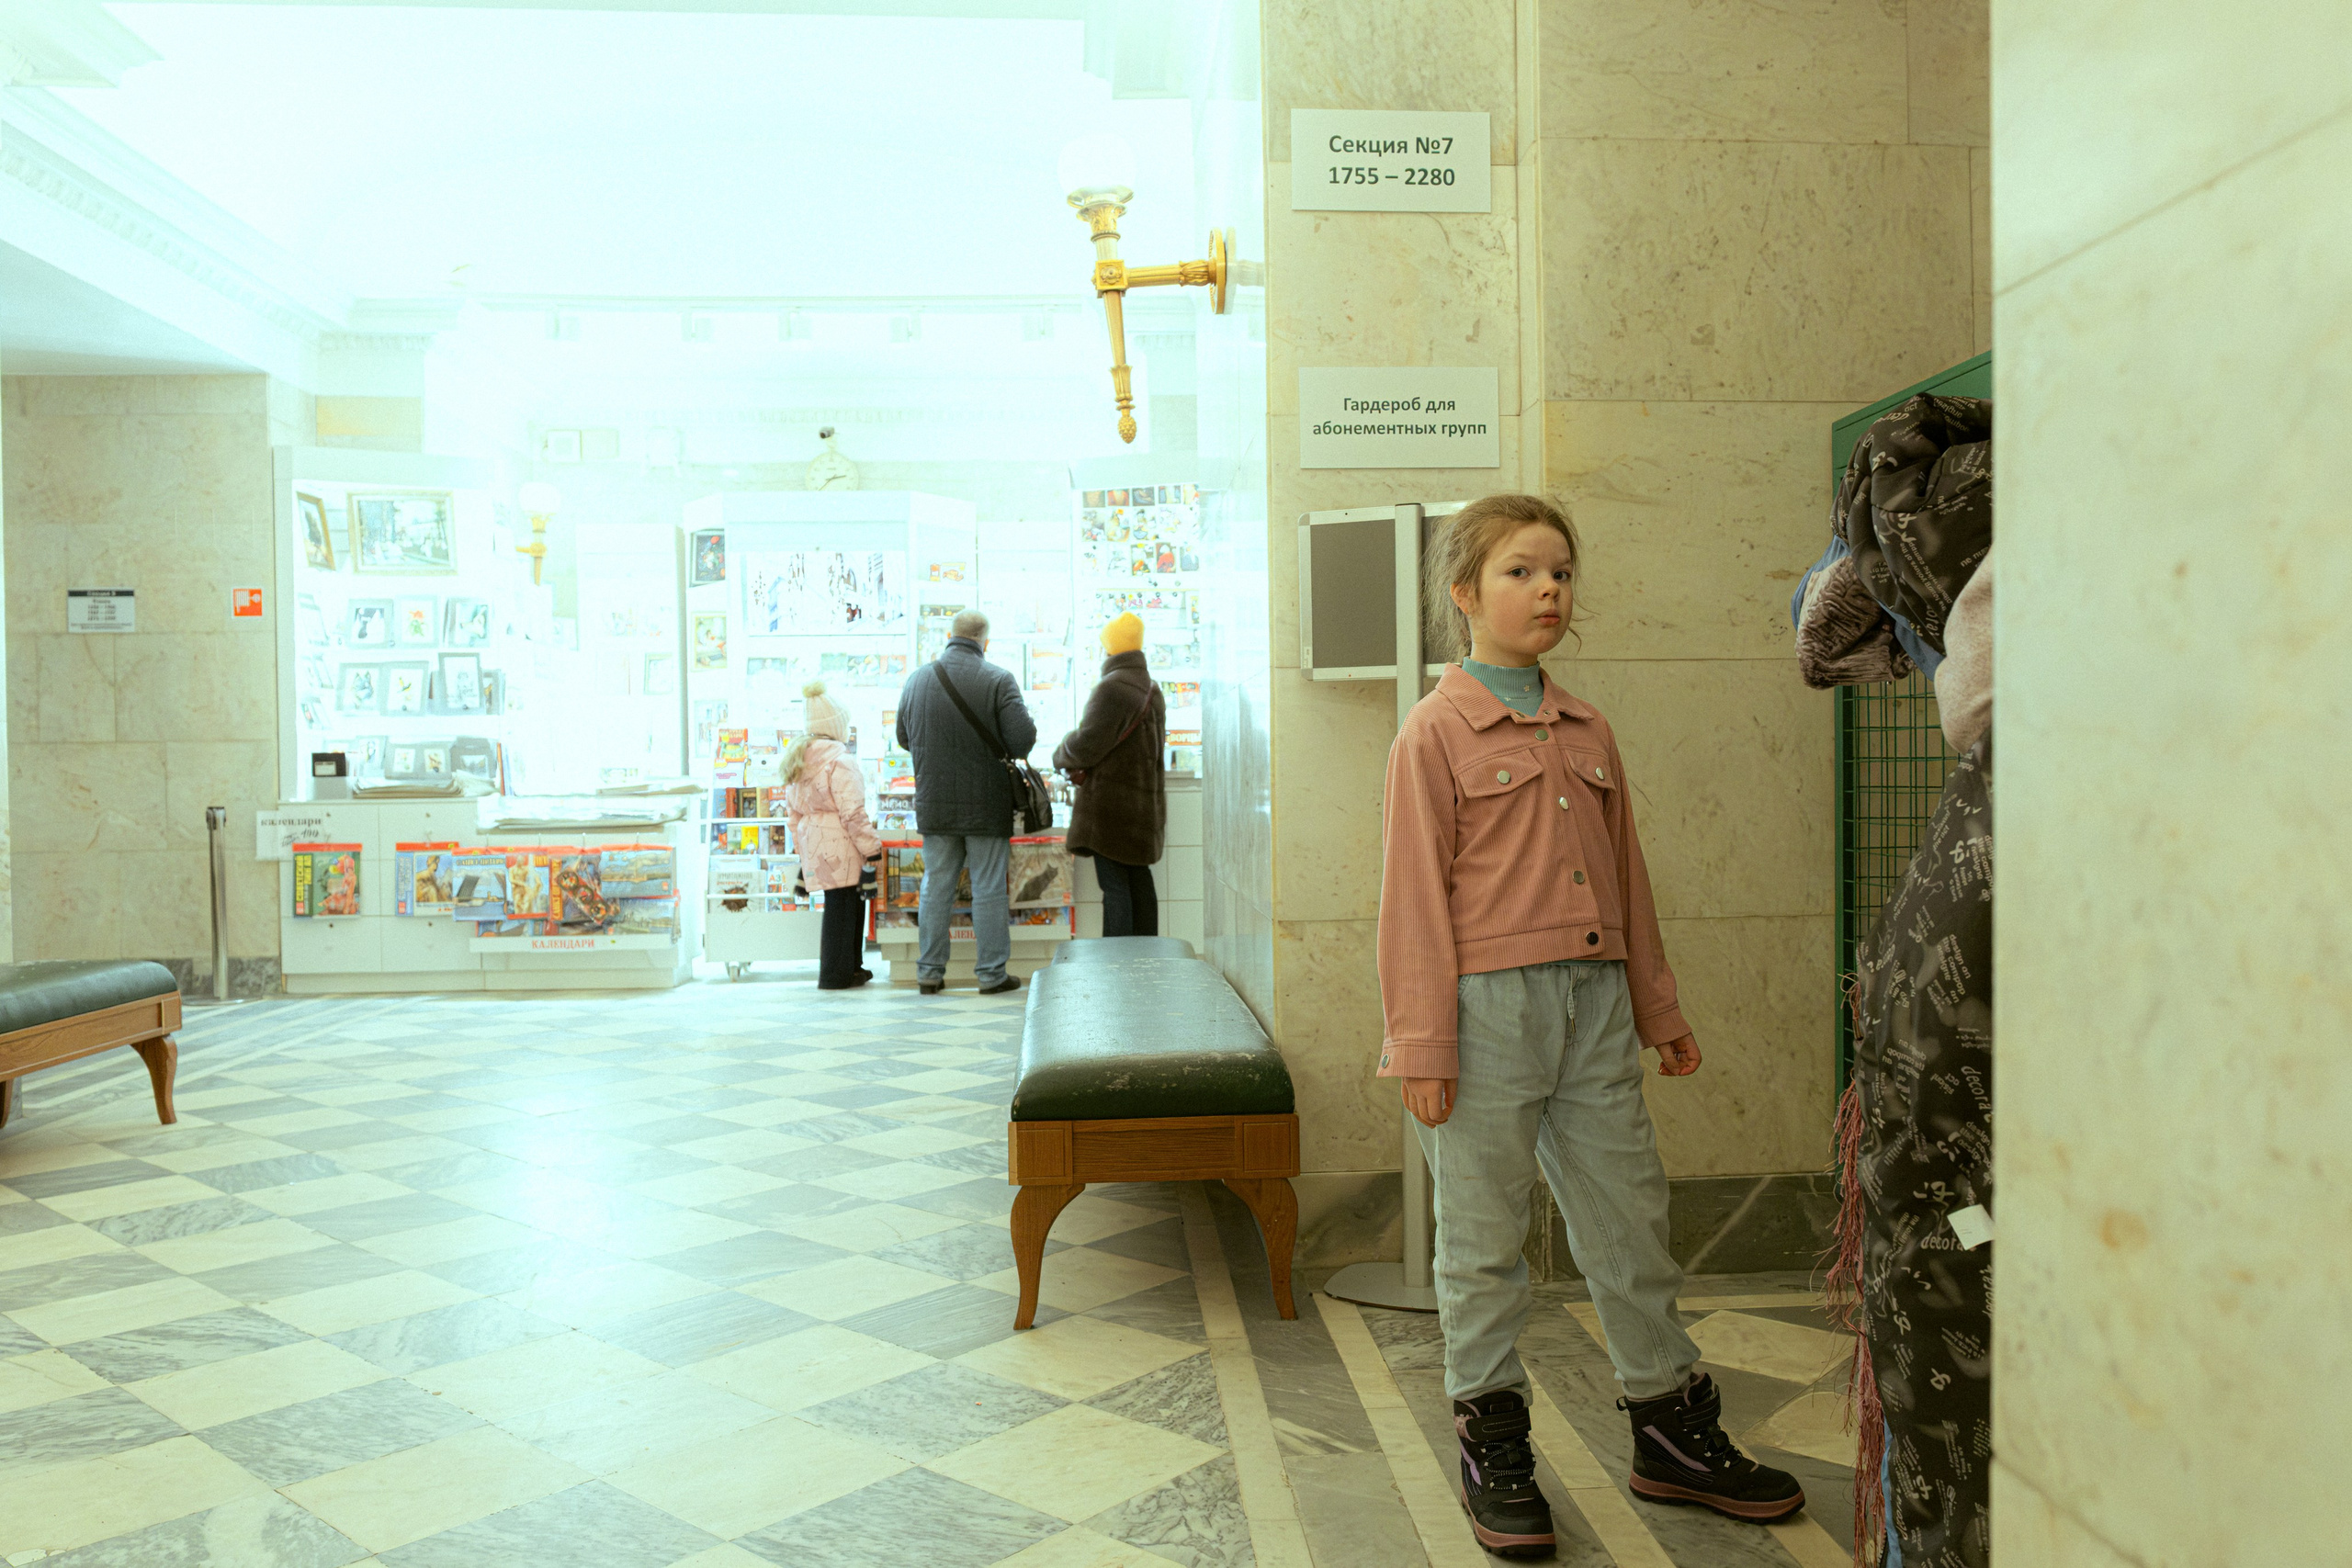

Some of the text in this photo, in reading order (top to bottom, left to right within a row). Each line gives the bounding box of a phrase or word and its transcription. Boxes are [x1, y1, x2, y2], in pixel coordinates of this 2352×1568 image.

[1329, 135, 1453, 157] Секция №7
[1329, 166, 1379, 185] 1755
[1404, 167, 1455, 186] 2280
[1342, 396, 1456, 414] Гардероб для
[1312, 419, 1487, 438] абонементных групп
[531, 939, 595, 950] КАЛЕНДАРИ
